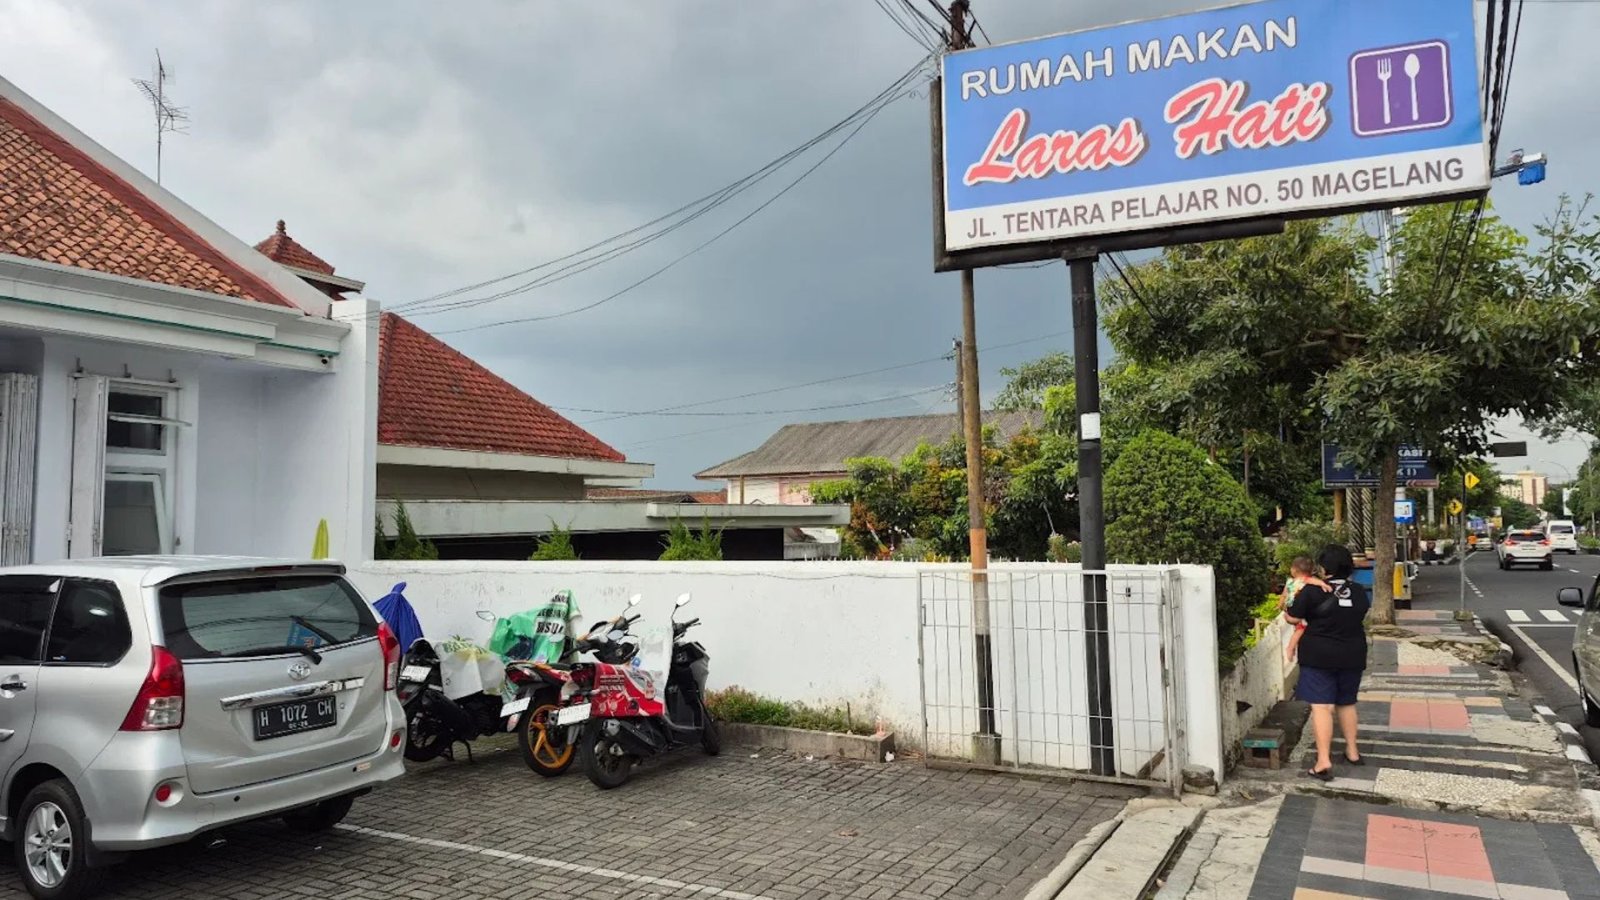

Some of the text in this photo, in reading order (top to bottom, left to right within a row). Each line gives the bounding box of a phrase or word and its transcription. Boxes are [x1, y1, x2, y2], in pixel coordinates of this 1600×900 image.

[961, 16, 1297, 101] RUMAH MAKAN
[963, 77, 1328, 186] Laras Hati
[966, 157, 1464, 239] JL. TENTARA PELAJAR NO. 50 MAGELANG
[260, 699, 332, 727] H 1072 CH
